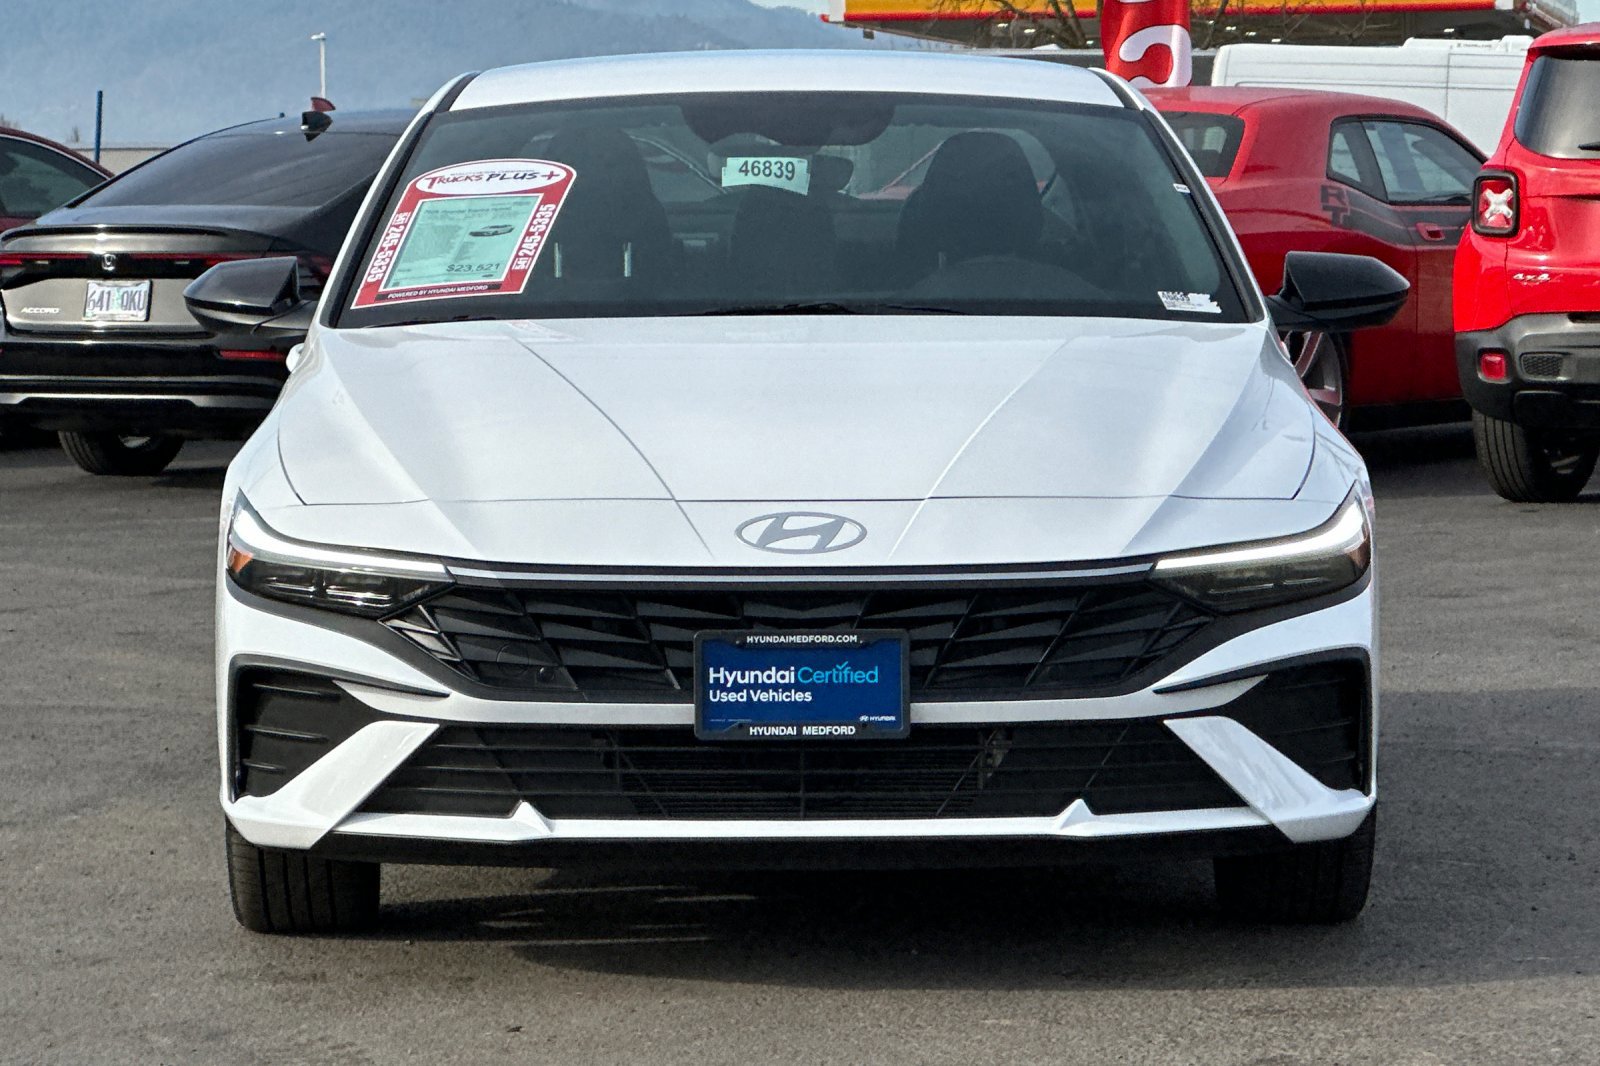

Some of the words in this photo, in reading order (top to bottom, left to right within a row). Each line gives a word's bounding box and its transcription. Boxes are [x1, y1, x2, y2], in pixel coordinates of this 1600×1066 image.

[738, 160, 796, 181] 46839
[424, 174, 484, 189] TRUCKS
[392, 211, 411, 225] 541
[517, 203, 557, 257] 245-5335
[366, 225, 405, 283] 245-5335
[446, 262, 500, 272] $23,521
[512, 256, 532, 270] 541
[387, 290, 419, 299] POWERED
[427, 286, 457, 295] HYUNDAI
[456, 284, 489, 292] MEDFORD
[87, 289, 111, 312] 641
[20, 307, 60, 315] ACCORD
[746, 634, 858, 644] HYUNDAIMEDFORD.COM
[708, 666, 795, 688] Hyundai
[797, 662, 879, 684] Certified
[709, 688, 747, 702] Used
[749, 688, 813, 702] Vehicles
[749, 725, 797, 736] HYUNDAI
[801, 725, 856, 735] MEDFORD
